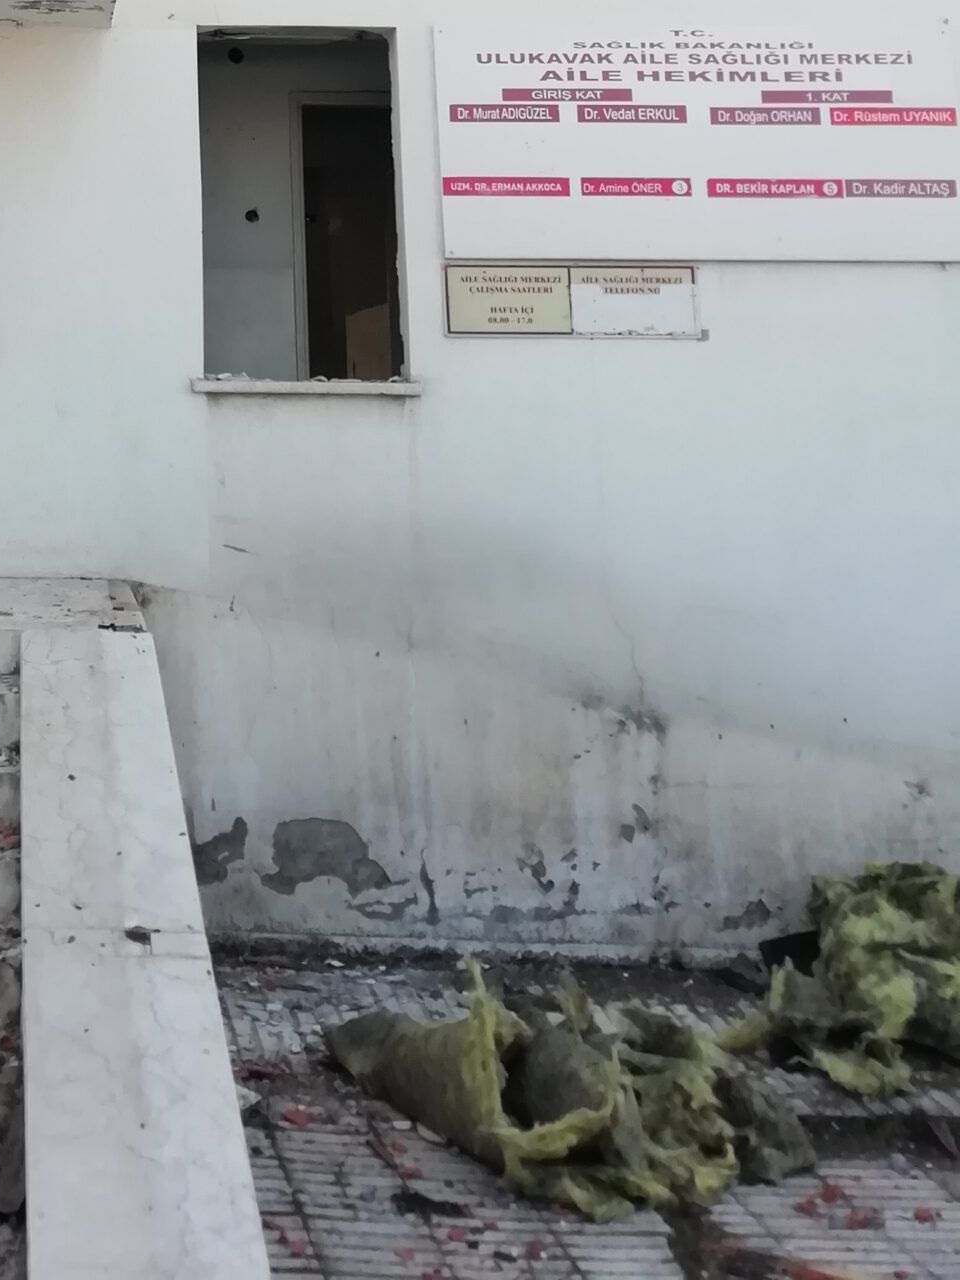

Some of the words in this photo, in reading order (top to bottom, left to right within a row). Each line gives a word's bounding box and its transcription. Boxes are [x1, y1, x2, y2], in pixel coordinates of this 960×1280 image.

[669, 29, 713, 37] T.C.
[573, 40, 665, 49] SAĞLIK
[675, 40, 814, 50] BAKANLIĞI
[476, 52, 614, 65] ULUKAVAK
[623, 50, 679, 65] AİLE
[688, 51, 789, 66] SAĞLIĞI
[799, 50, 913, 65] MERKEZİ
[540, 67, 622, 82] AİLE
[636, 68, 844, 82] HEKİMLERİ
[531, 89, 572, 101] GİRİŞ
[575, 90, 603, 100] KAT
[806, 92, 817, 102] 1.
[821, 92, 850, 102] KAT
[457, 108, 471, 120] Dr.
[473, 108, 500, 120] Murat
[501, 106, 553, 120] ADIGÜZEL
[584, 108, 600, 120] Dr.
[602, 108, 636, 120] Vedat
[638, 108, 680, 121] ERKUL
[718, 111, 733, 122] Dr.
[735, 111, 768, 125] Doğan
[770, 111, 812, 122] ORHAN
[833, 111, 851, 122] Dr.
[856, 111, 901, 122] Rüstem
[904, 111, 952, 123] UYANIK
[450, 182, 473, 191] UZM.
[474, 182, 490, 191] DR.
[491, 182, 524, 191] ERMAN
[525, 182, 562, 192] AKKOCA
[583, 182, 596, 193] Dr.
[598, 182, 629, 193] Amine
[631, 181, 663, 193] ÖNER
[715, 183, 734, 193] DR.
[736, 182, 769, 194] BEKİR
[771, 183, 815, 194] KAPLAN
[852, 183, 871, 194] Dr.
[873, 183, 906, 194] Kadir
[908, 183, 950, 197] ALTAŞ
[482, 275, 518, 283] SAĞLIĞI
[520, 275, 561, 283] MERKEZİ
[602, 275, 638, 284] SAĞLIĞI
[469, 286, 508, 295] ÇALIŞMA
[510, 286, 553, 294] SAATLERİ
[490, 306, 518, 314] HAFTA
[521, 306, 534, 315] İÇİ
